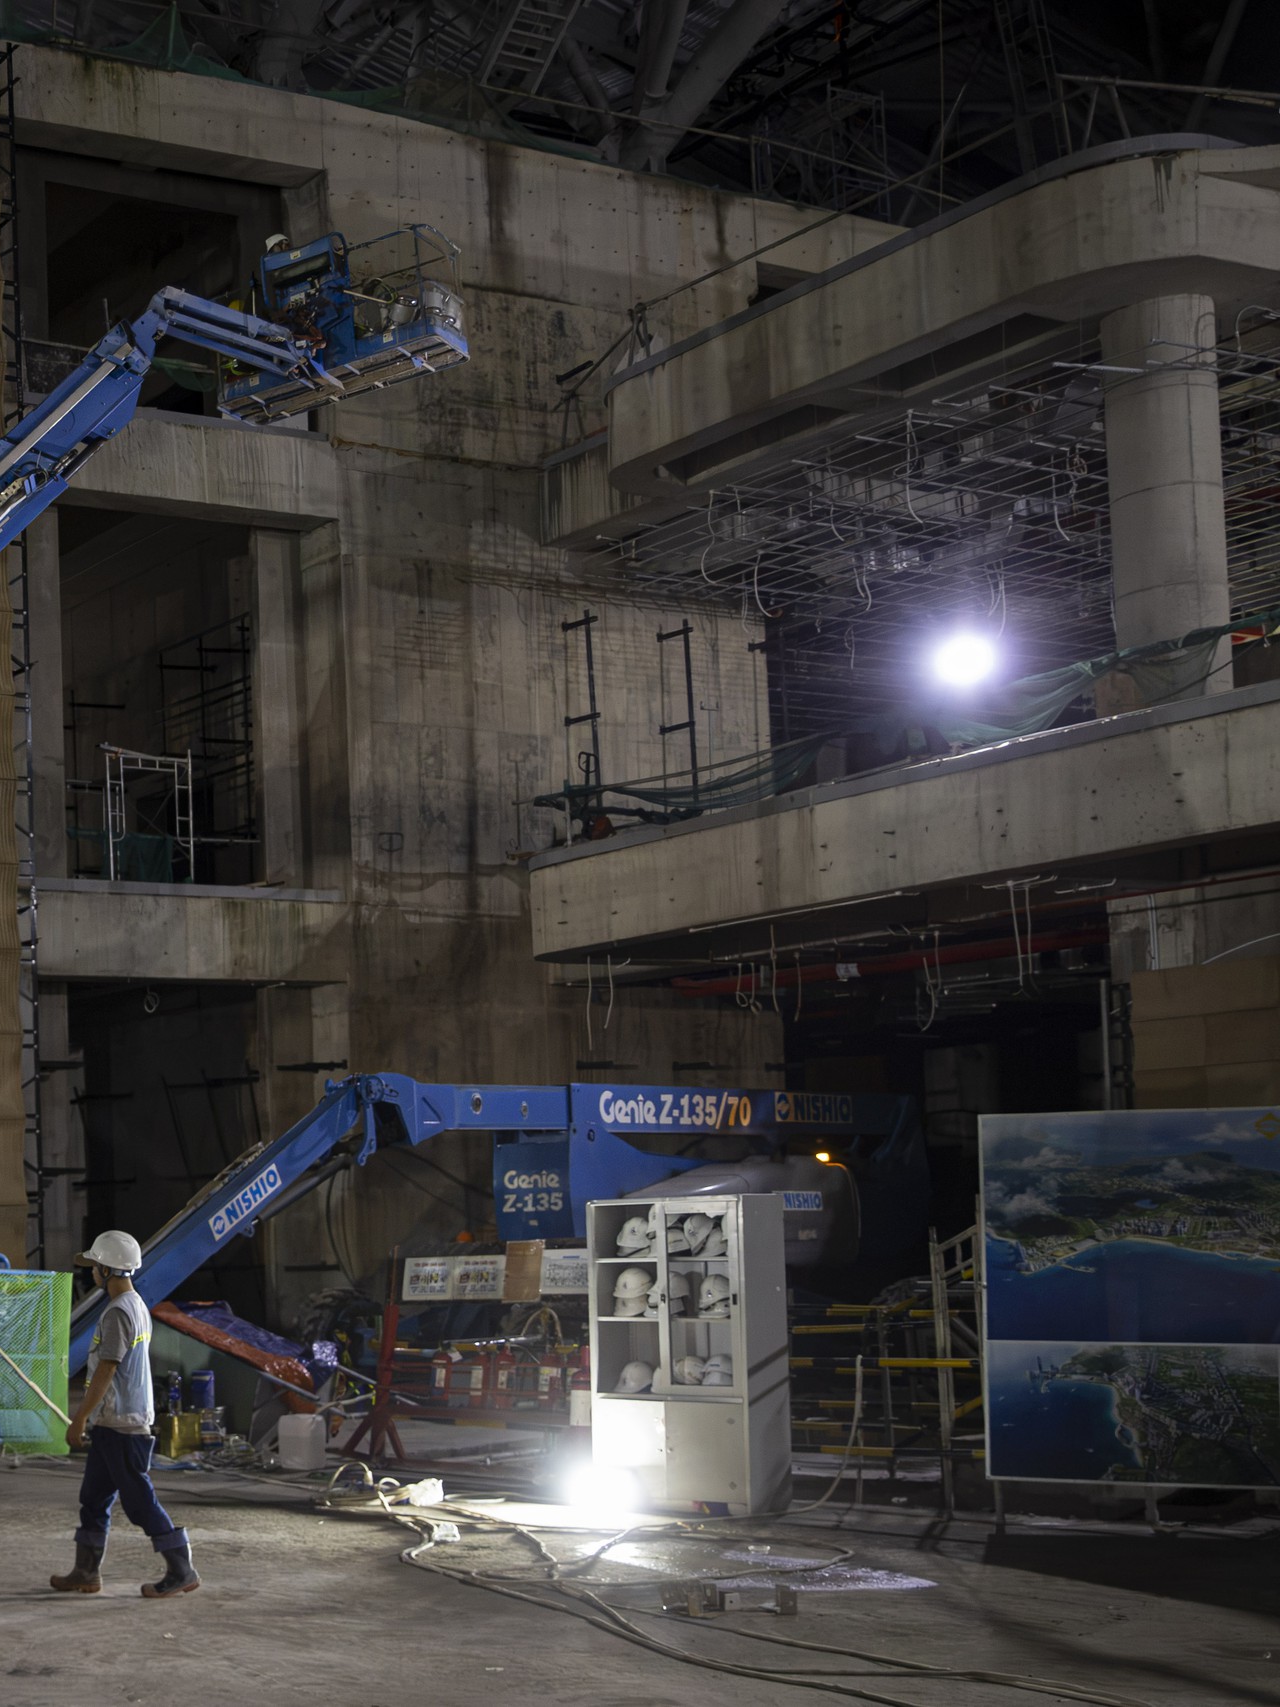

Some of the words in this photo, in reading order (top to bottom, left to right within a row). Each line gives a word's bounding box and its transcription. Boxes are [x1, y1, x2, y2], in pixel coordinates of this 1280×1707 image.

[599, 1090, 656, 1125] Genie
[659, 1091, 751, 1130] Z-135/70
[793, 1095, 851, 1122] NISHIO
[503, 1169, 560, 1189] Genie
[224, 1169, 278, 1224] NISHIO
[502, 1192, 563, 1213] Z-135
[783, 1192, 821, 1209] NISHIO
